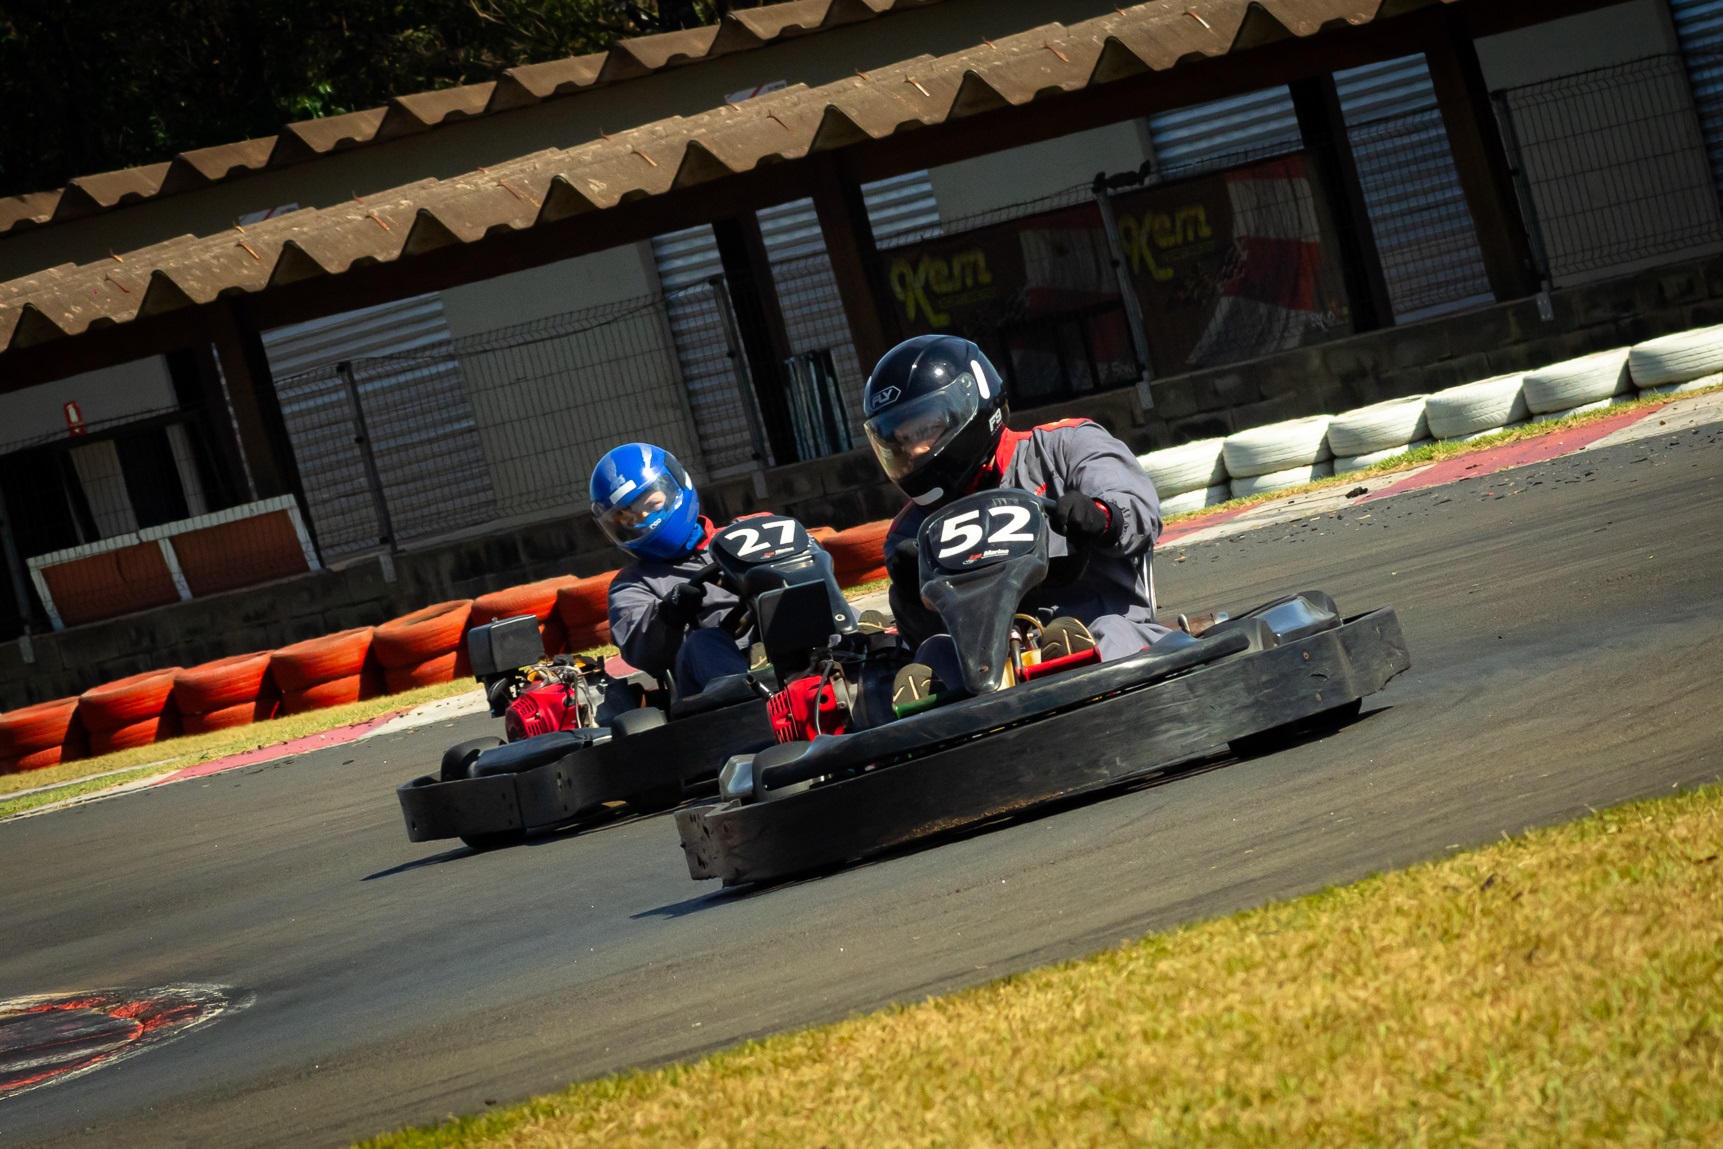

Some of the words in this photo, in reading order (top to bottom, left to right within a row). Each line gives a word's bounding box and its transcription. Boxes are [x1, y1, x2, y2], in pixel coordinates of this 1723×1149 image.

[872, 388, 893, 408] FLY
[989, 407, 1002, 432] F9
[724, 520, 796, 557] 27
[938, 505, 1034, 558] 52
